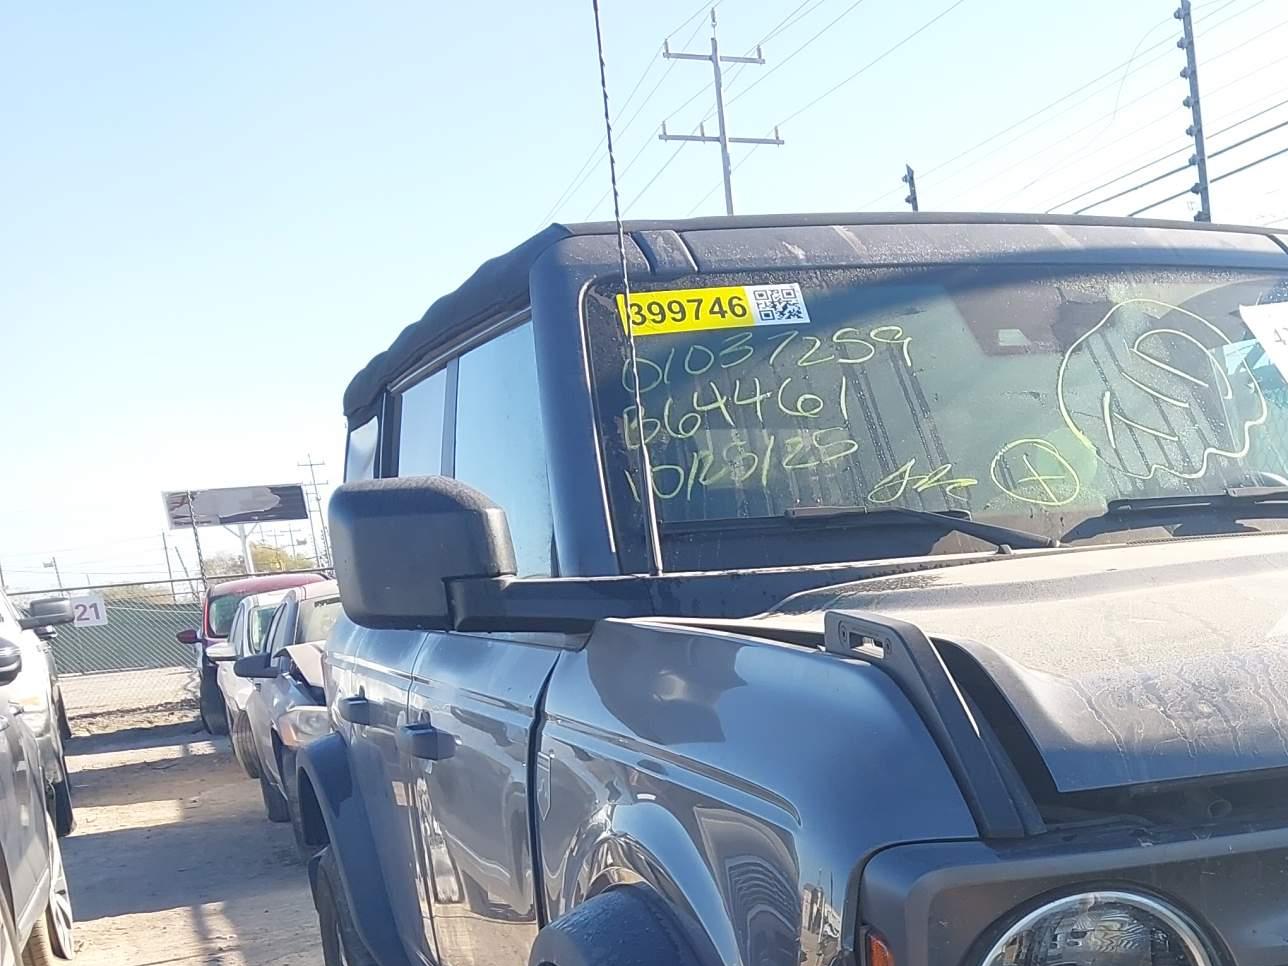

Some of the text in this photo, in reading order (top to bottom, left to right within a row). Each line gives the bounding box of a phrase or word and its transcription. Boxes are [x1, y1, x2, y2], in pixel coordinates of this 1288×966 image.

[630, 296, 747, 326] 399746
[622, 326, 912, 393] 01037259
[75, 602, 100, 621] 21
